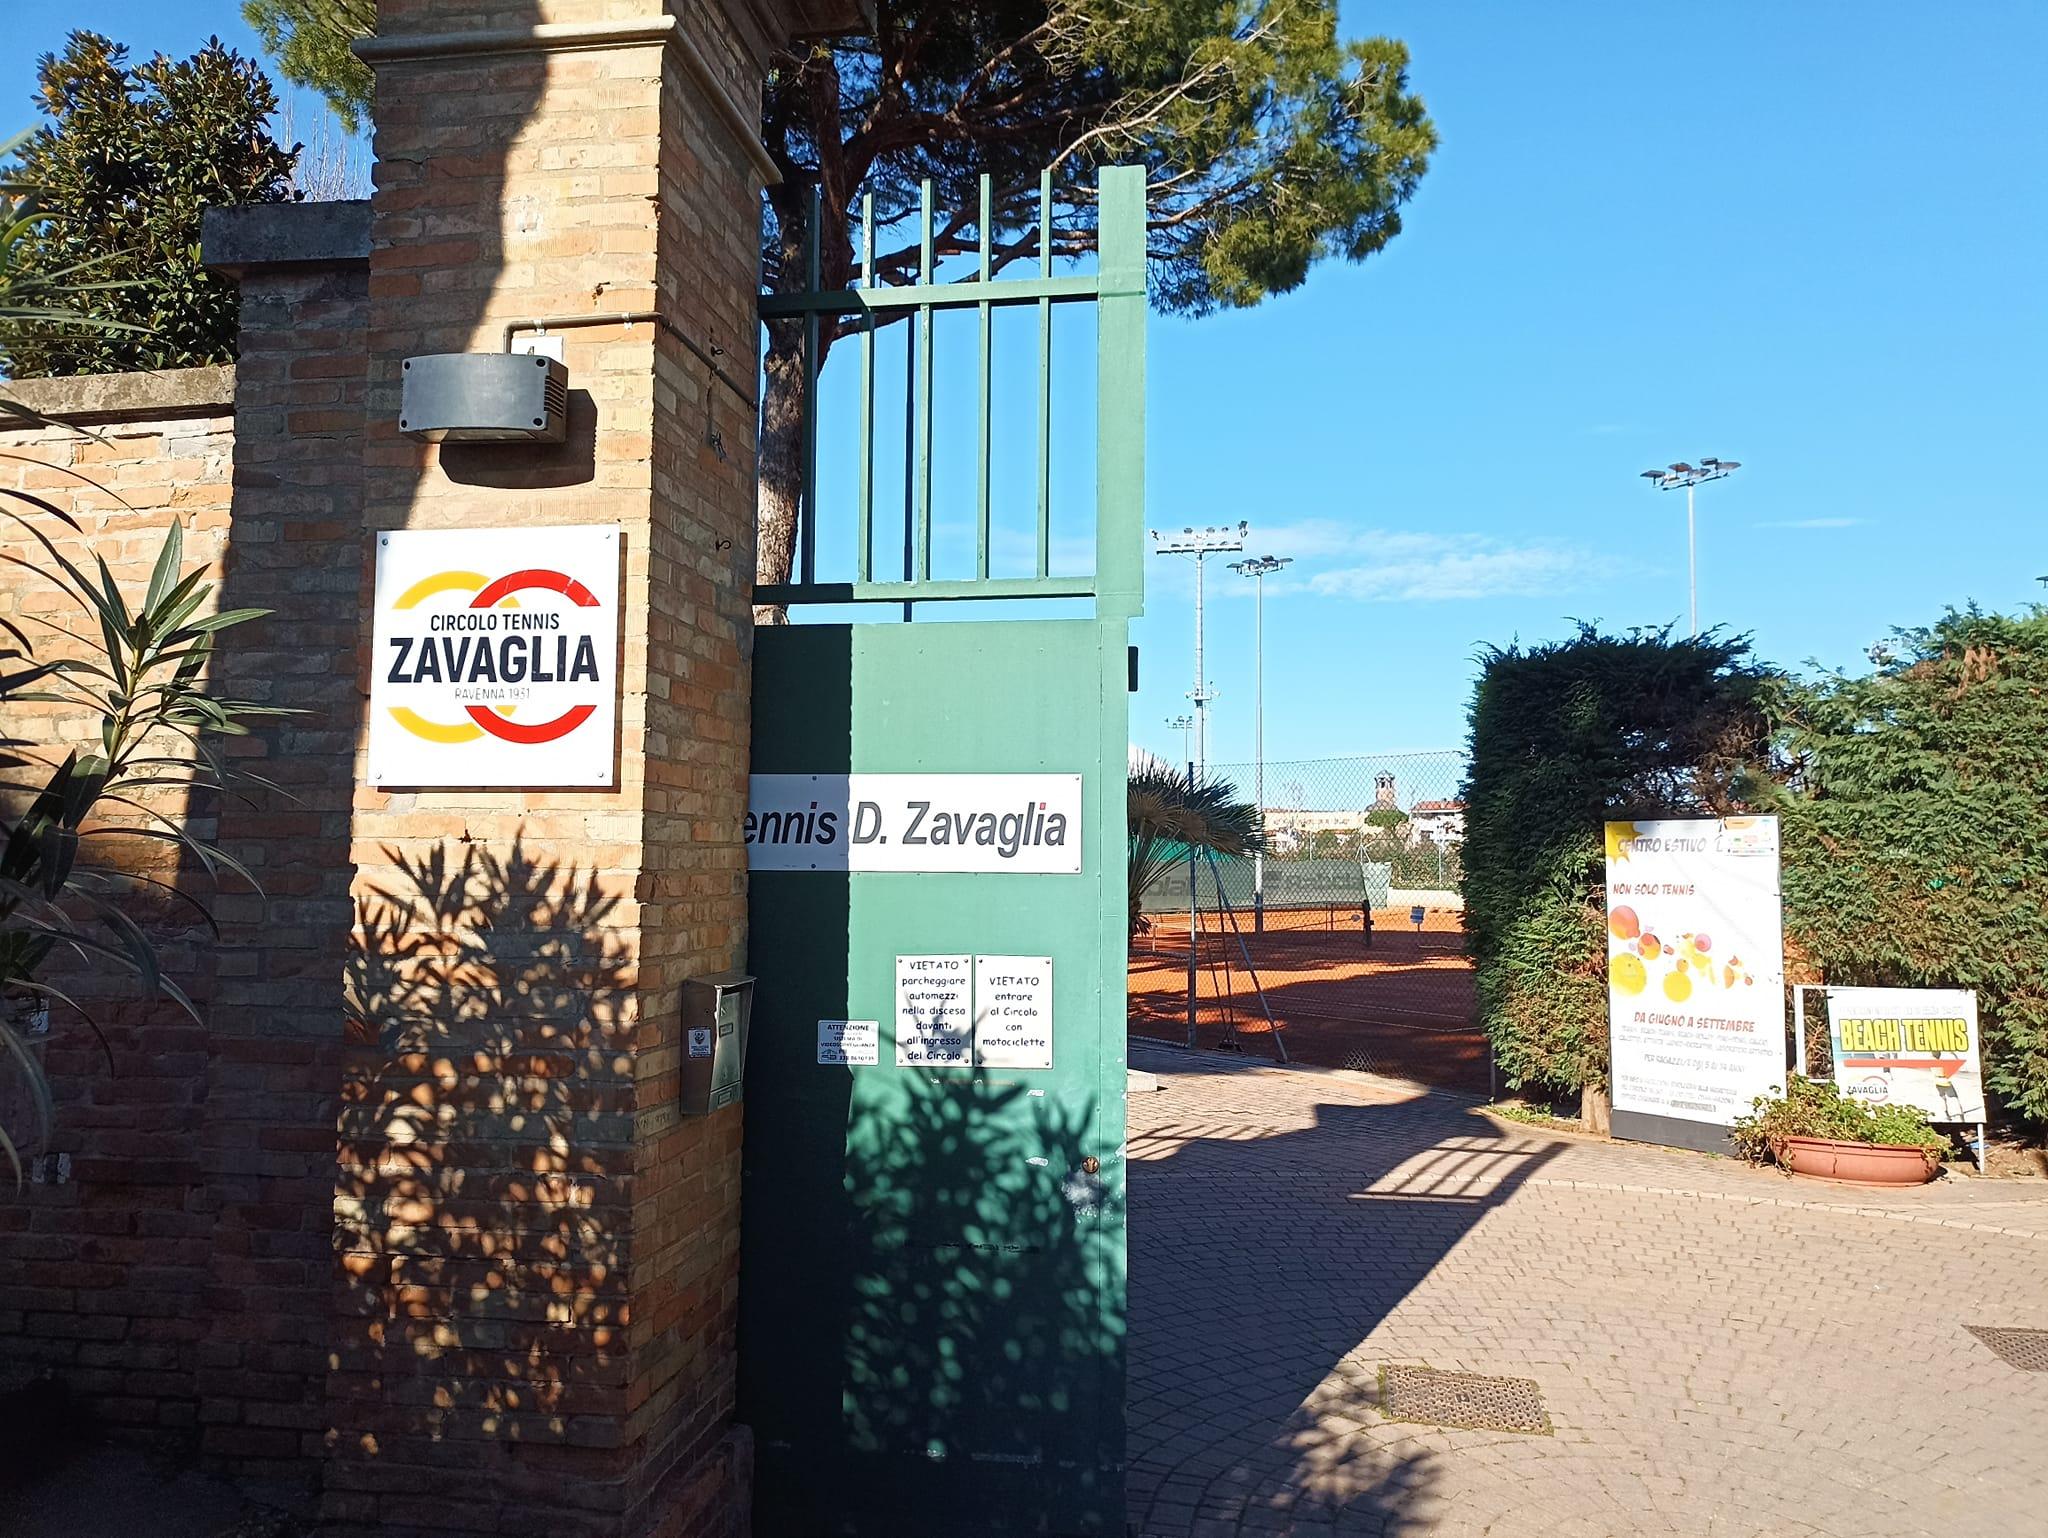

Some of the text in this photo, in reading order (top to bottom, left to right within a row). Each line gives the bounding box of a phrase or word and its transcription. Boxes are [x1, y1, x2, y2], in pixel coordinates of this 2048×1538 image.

[430, 612, 560, 632] CIRCOLO TENNIS
[387, 634, 600, 684] ZAVAGLIA
[454, 686, 531, 701] RAVENNA 1931
[852, 801, 888, 845] D.
[902, 801, 1068, 859] Zavaglia
[1617, 837, 1662, 853] CENTRO
[1612, 883, 1696, 896] NON SOLO TENNIS
[909, 960, 959, 971] VIETATO
[901, 976, 966, 989] parcheggiare
[989, 976, 1040, 987] VIETATO
[908, 991, 960, 1001] automezzi
[994, 993, 1033, 1001] entrare
[902, 1005, 966, 1016] nella discesa
[990, 1006, 1038, 1017] al Circolo
[915, 1021, 953, 1032] davanti
[1005, 1022, 1023, 1032] con
[1634, 1011, 1756, 1033] DA GIUGNO A SETTEMBRE
[1839, 1018, 1970, 1052] BEACH TENNIS
[906, 1036, 962, 1048] all'ingresso
[982, 1037, 1046, 1047] motociclette
[907, 1051, 961, 1061] del Circolo
[1846, 1084, 1889, 1096] ZAVAGLIA
